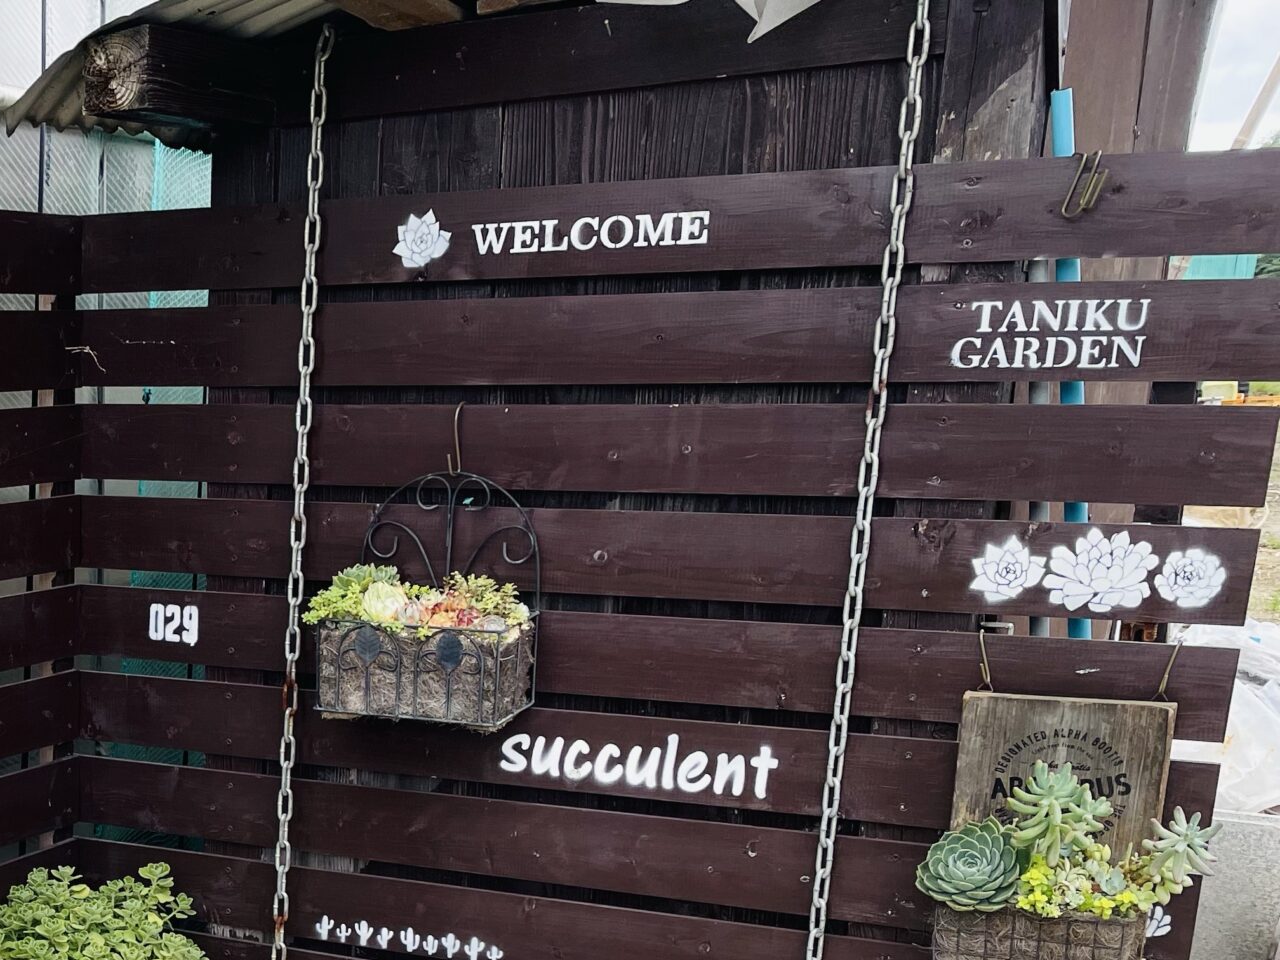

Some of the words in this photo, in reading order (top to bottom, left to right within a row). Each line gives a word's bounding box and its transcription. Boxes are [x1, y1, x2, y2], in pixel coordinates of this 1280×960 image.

[471, 210, 710, 256] WELCOME
[971, 298, 1151, 333] TANIKU
[949, 335, 1147, 369] GARDEN
[148, 603, 199, 647] 029
[499, 733, 779, 799] succulent
[1053, 728, 1088, 743] ALPHA
[1091, 737, 1124, 767] BOOTIS
[990, 773, 1132, 800] ARRUS
